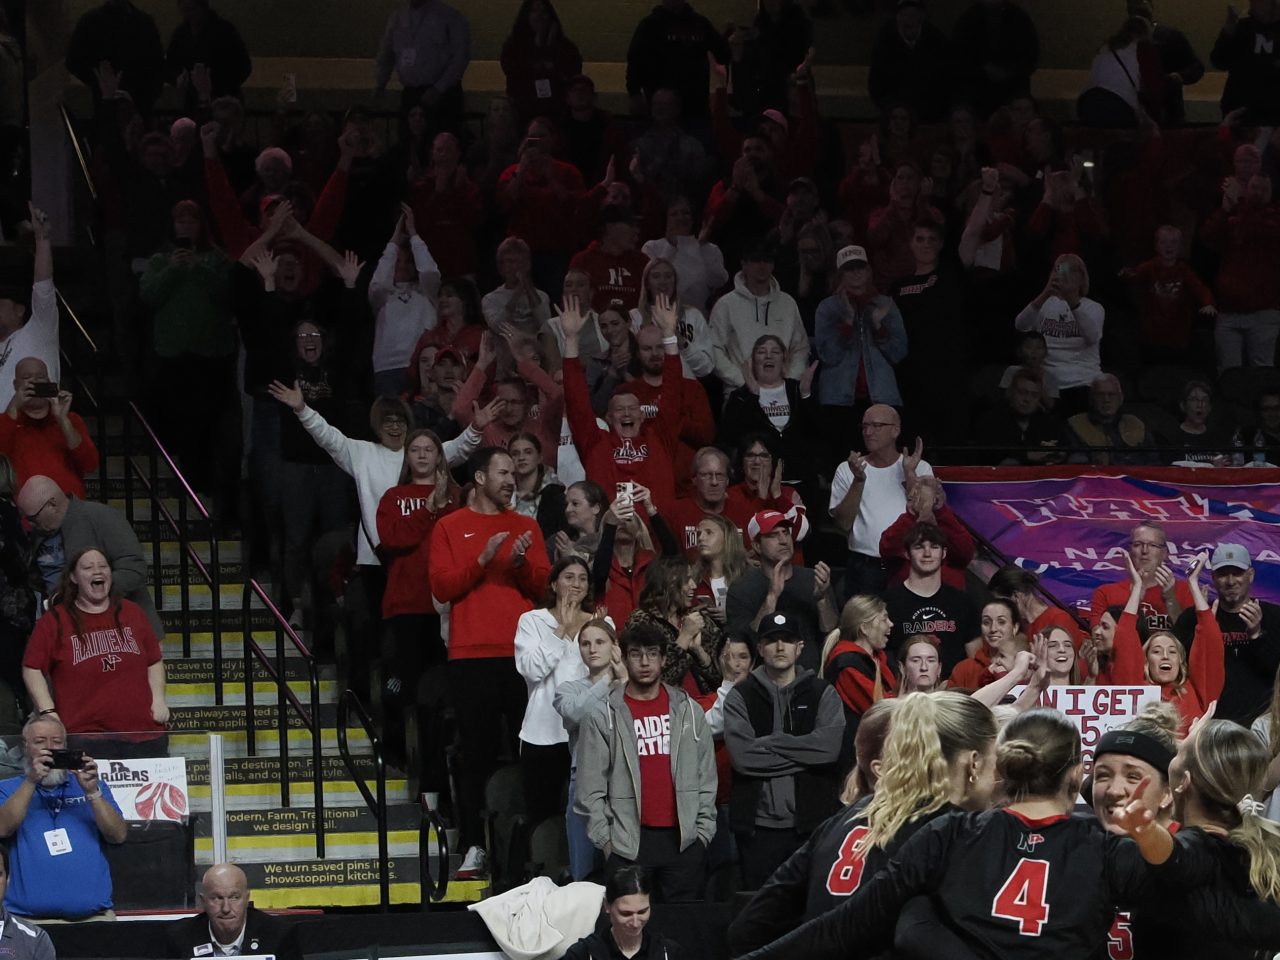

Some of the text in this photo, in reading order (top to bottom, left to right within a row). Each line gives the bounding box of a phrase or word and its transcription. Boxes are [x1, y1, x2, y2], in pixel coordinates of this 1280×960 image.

[1253, 32, 1274, 54] N
[685, 531, 698, 550] NO
[902, 619, 957, 634] RAIDERS
[1147, 614, 1172, 630] ERS
[71, 626, 140, 666] RAIDERS
[176, 661, 201, 670] cave
[203, 661, 213, 669] to
[167, 670, 214, 680] basemen
[1065, 689, 1086, 715] I
[1093, 689, 1144, 715] GET
[172, 711, 192, 720] you
[194, 709, 229, 719] always
[231, 707, 271, 717] wated
[177, 717, 201, 728] with
[203, 717, 216, 726] an
[218, 714, 269, 729] applince
[633, 714, 670, 739] AIDE
[241, 758, 302, 771] destinaon.
[101, 770, 149, 783] AIDERS
[224, 769, 246, 781] alls,
[248, 770, 269, 780] and
[320, 766, 345, 779] tyle.
[267, 811, 299, 822] Farm,
[300, 808, 359, 820] Traitional
[253, 823, 275, 832] we
[277, 820, 309, 833] design
[264, 864, 283, 874] We
[285, 862, 309, 873] turn
[311, 861, 344, 872] saved
[347, 859, 370, 873] pins
[826, 826, 869, 896] 8
[264, 869, 398, 884] showstopping kitches.
[991, 857, 1050, 937] 4
